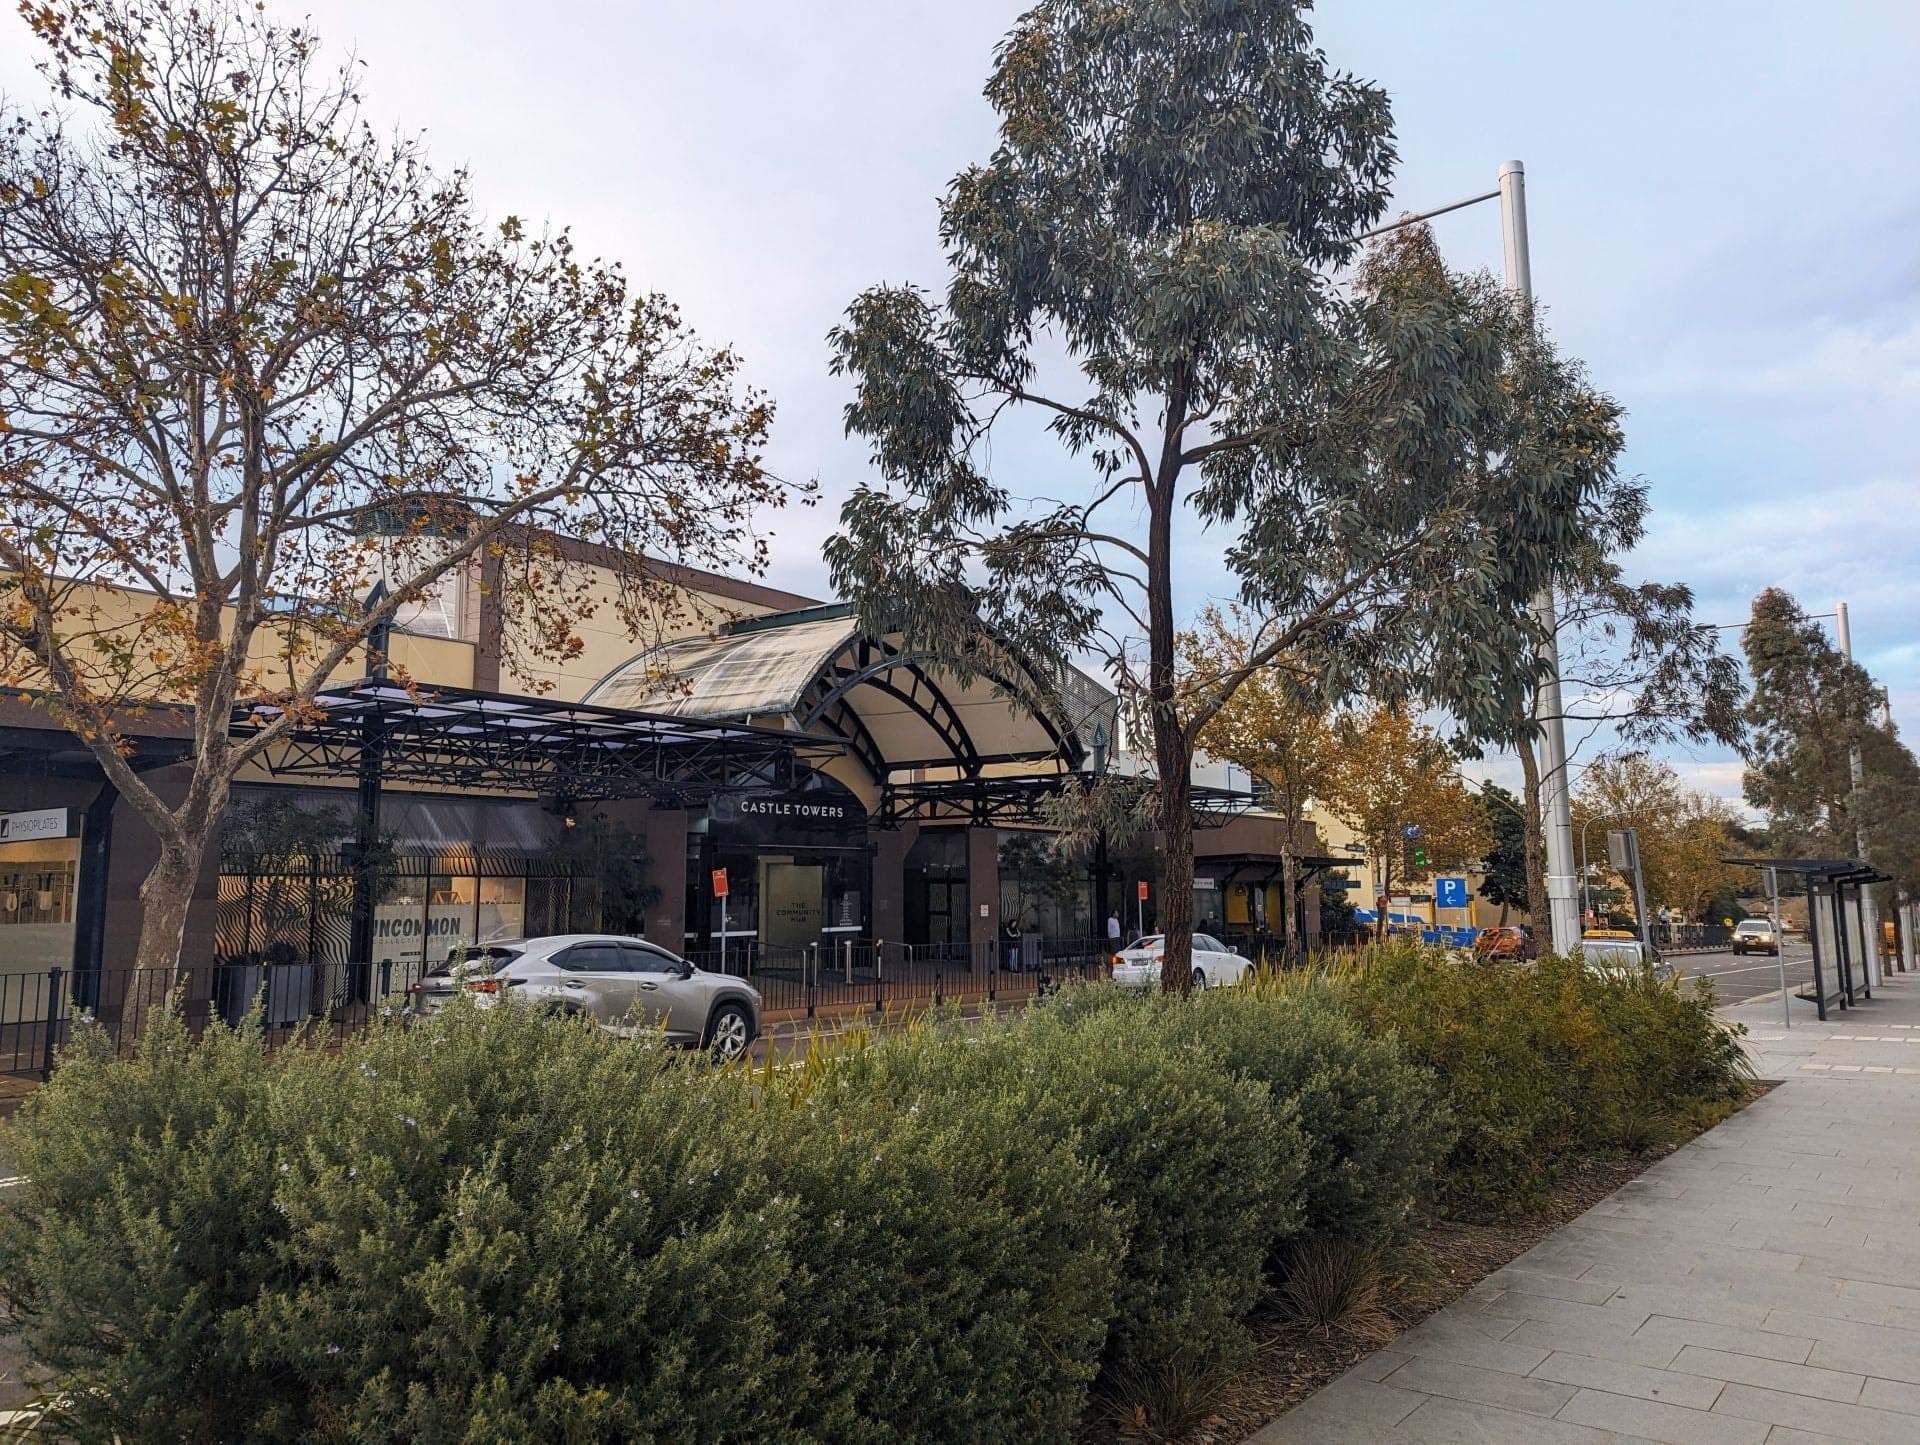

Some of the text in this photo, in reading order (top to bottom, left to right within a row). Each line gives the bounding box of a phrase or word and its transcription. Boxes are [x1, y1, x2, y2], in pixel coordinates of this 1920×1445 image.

[740, 801, 844, 818] CASTLE TOWERS
[1444, 880, 1456, 895] P
